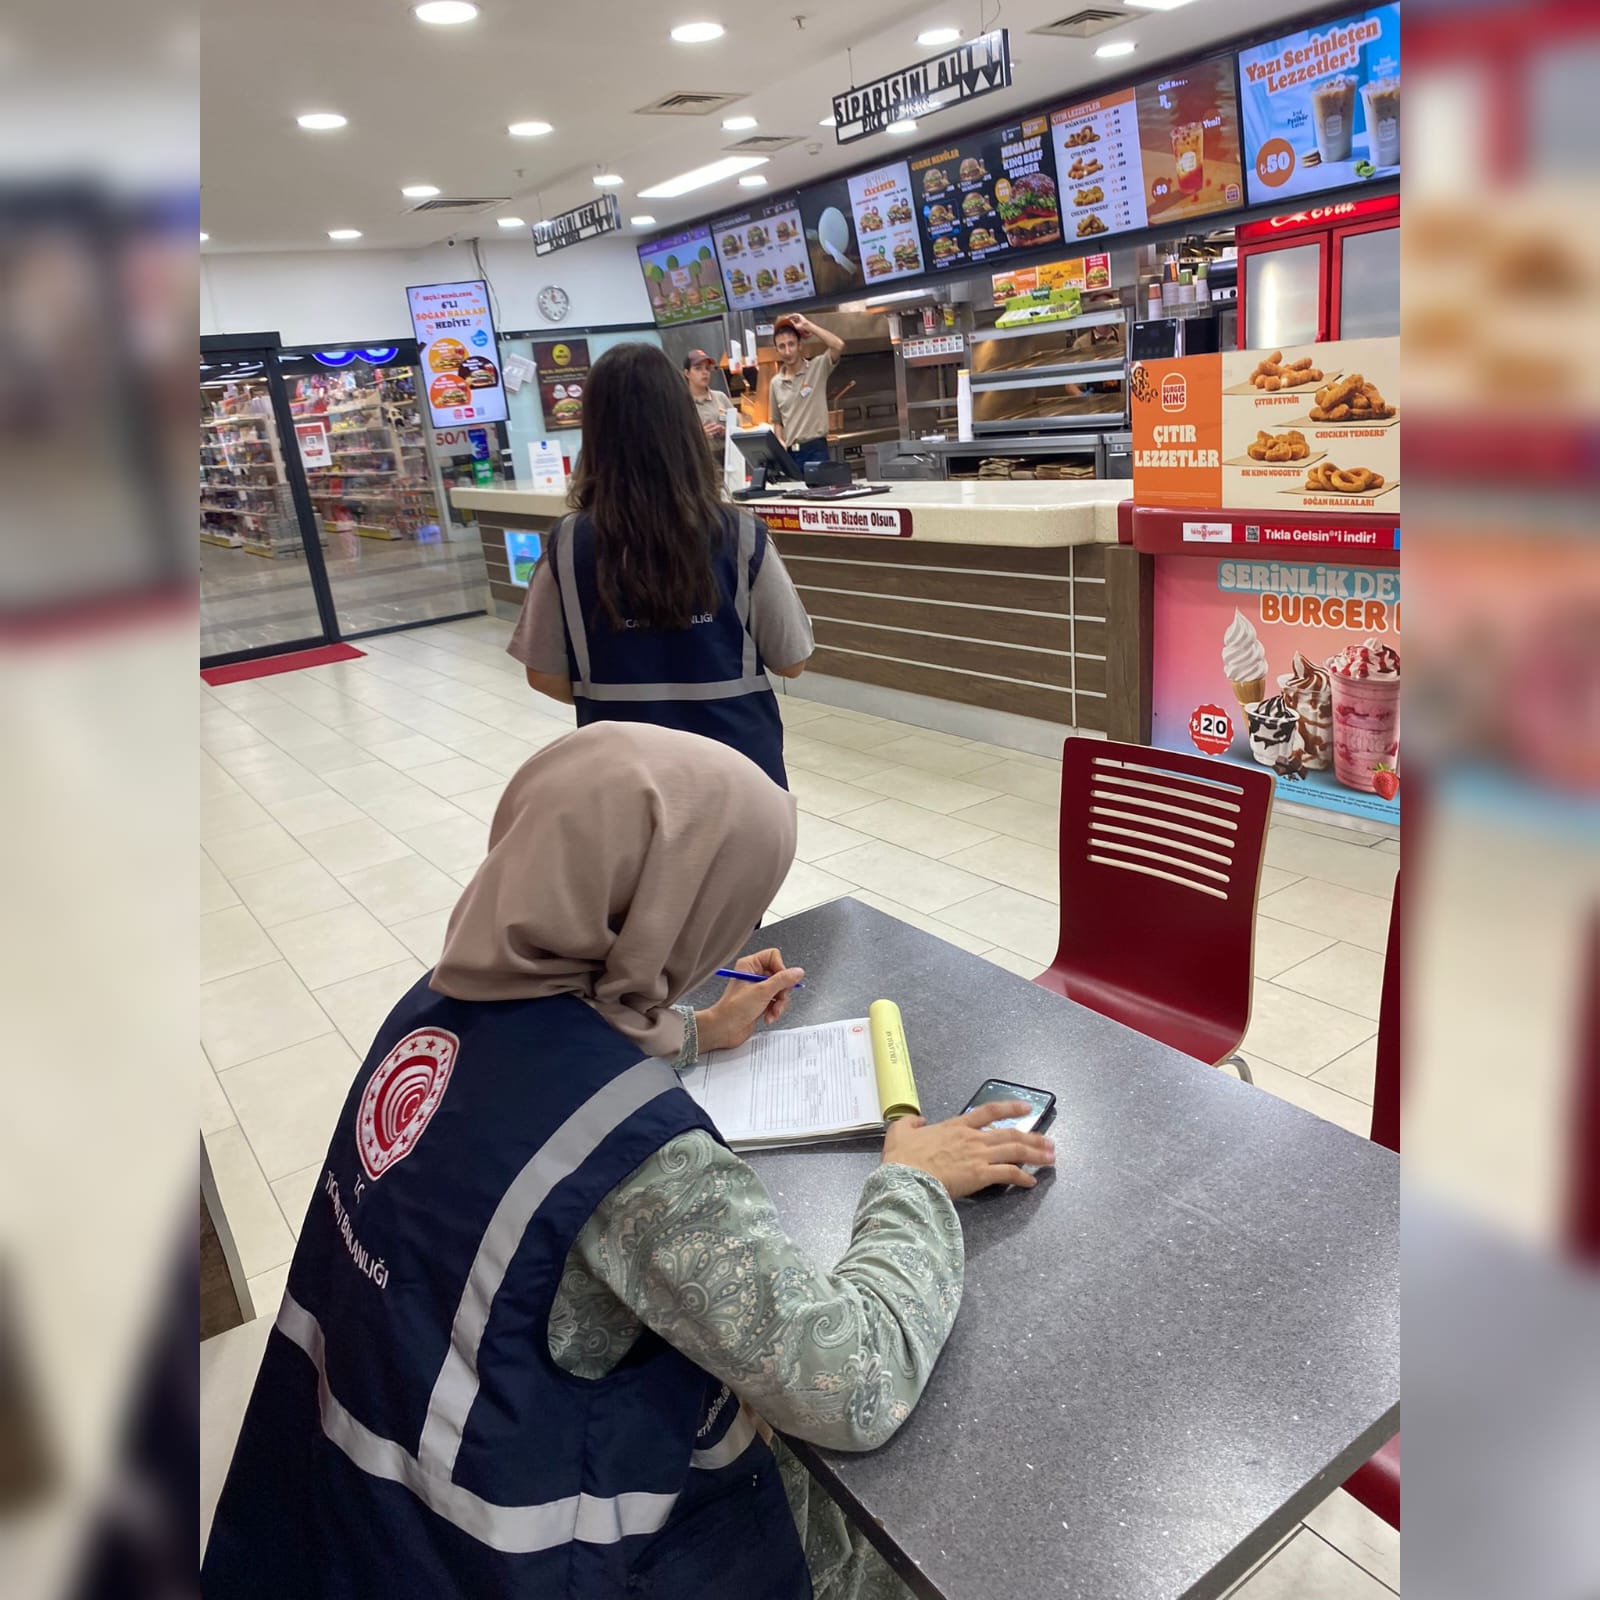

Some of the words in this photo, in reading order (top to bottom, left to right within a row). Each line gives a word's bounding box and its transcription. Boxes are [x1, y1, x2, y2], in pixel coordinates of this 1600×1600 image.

[1245, 57, 1282, 83] Yazı
[1283, 21, 1379, 69] Serinleten
[1267, 45, 1356, 93] Lezzetler!
[1009, 161, 1040, 180] BURGER
[435, 318, 471, 329] HEDİYE!
[1163, 385, 1185, 393] BURGER
[1163, 393, 1185, 404] KING
[1152, 424, 1197, 449] ÇITIR
[1315, 430, 1348, 440] CHICKEN
[1134, 449, 1220, 468] LEZZETLER
[1251, 469, 1268, 477] KING
[1303, 496, 1328, 507] SOĞAN
[1328, 497, 1375, 507] HALKALARI
[802, 509, 820, 525] Fiyat
[821, 511, 839, 525] Farkı
[841, 511, 868, 527] Bizden
[870, 513, 897, 528] Olsun.
[1264, 529, 1291, 541] Tıkla
[1343, 531, 1377, 544] indir!
[1261, 594, 1388, 632] BURGER
